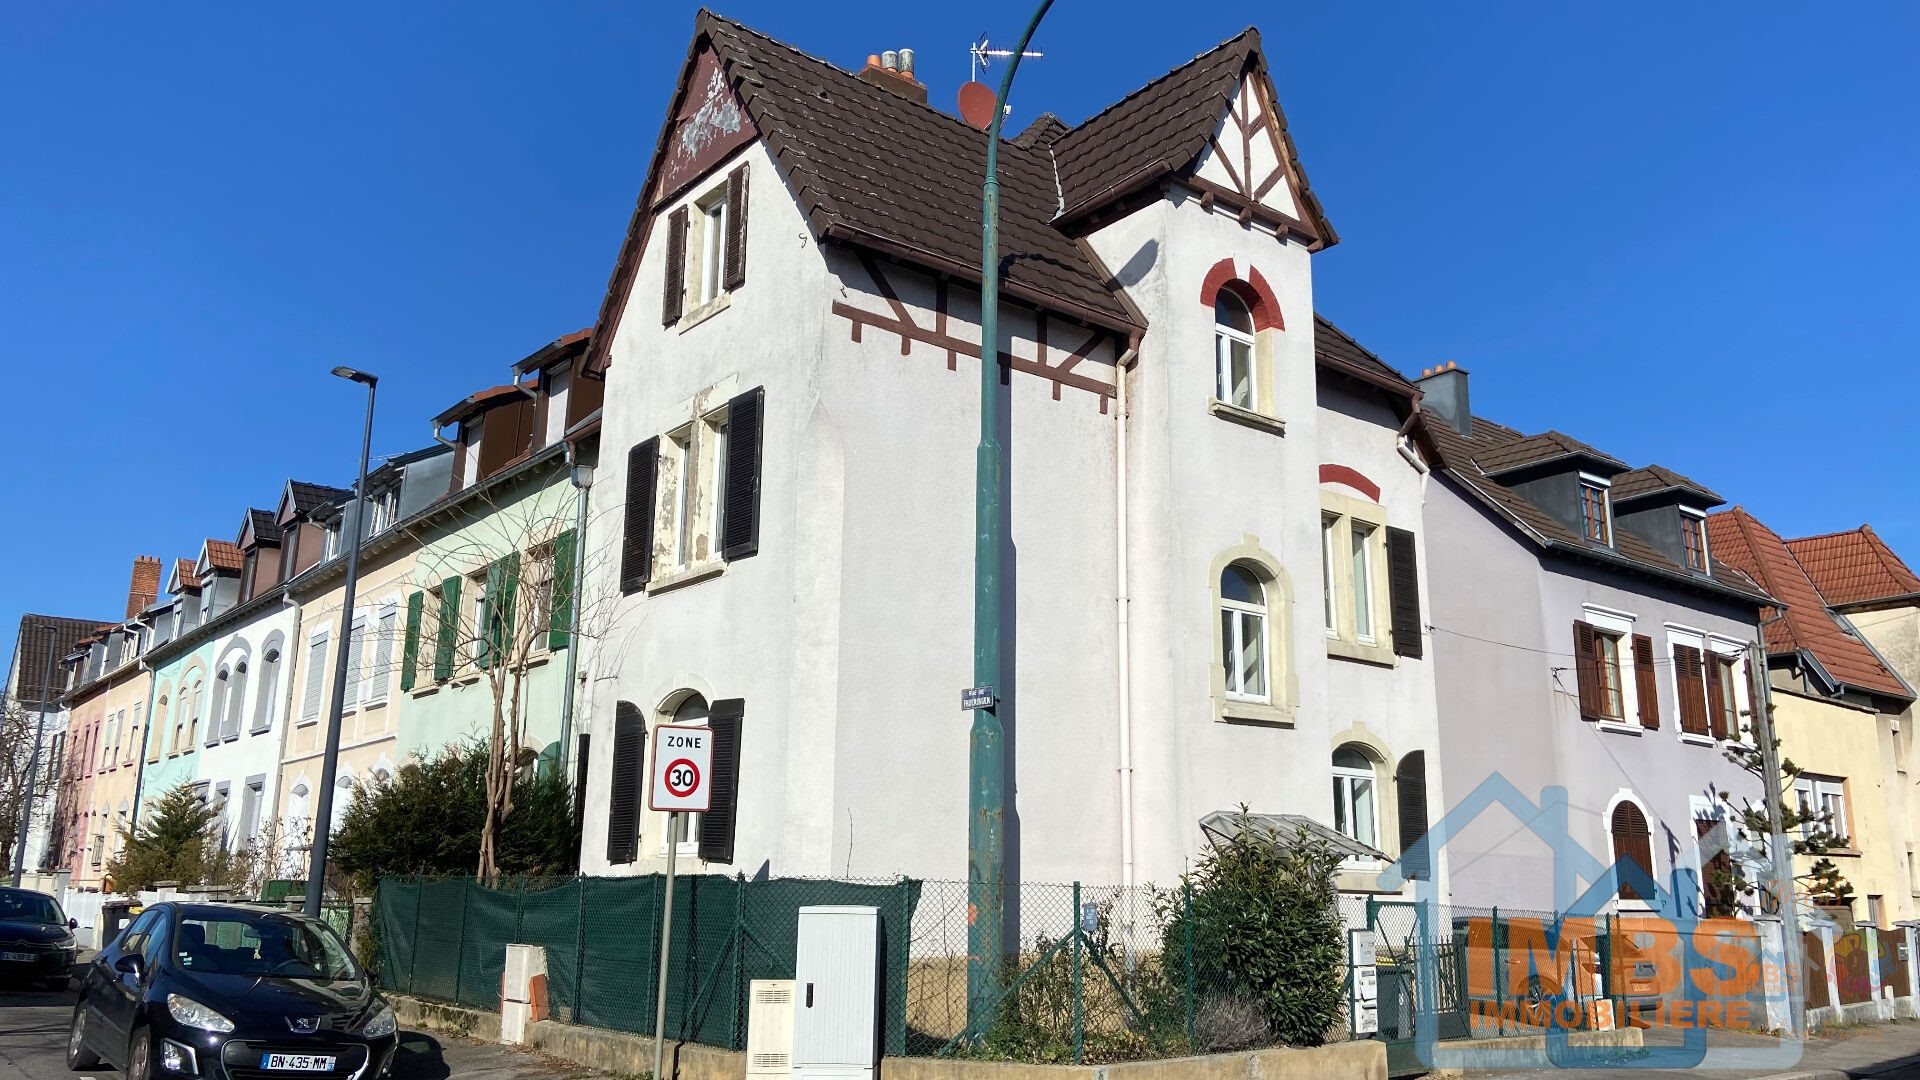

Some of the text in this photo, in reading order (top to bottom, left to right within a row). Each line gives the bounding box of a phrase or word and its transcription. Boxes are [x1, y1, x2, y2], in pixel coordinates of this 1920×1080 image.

[667, 735, 702, 749] ZONE
[671, 768, 694, 787] 30
[270, 1055, 328, 1069] BN-435-MM
